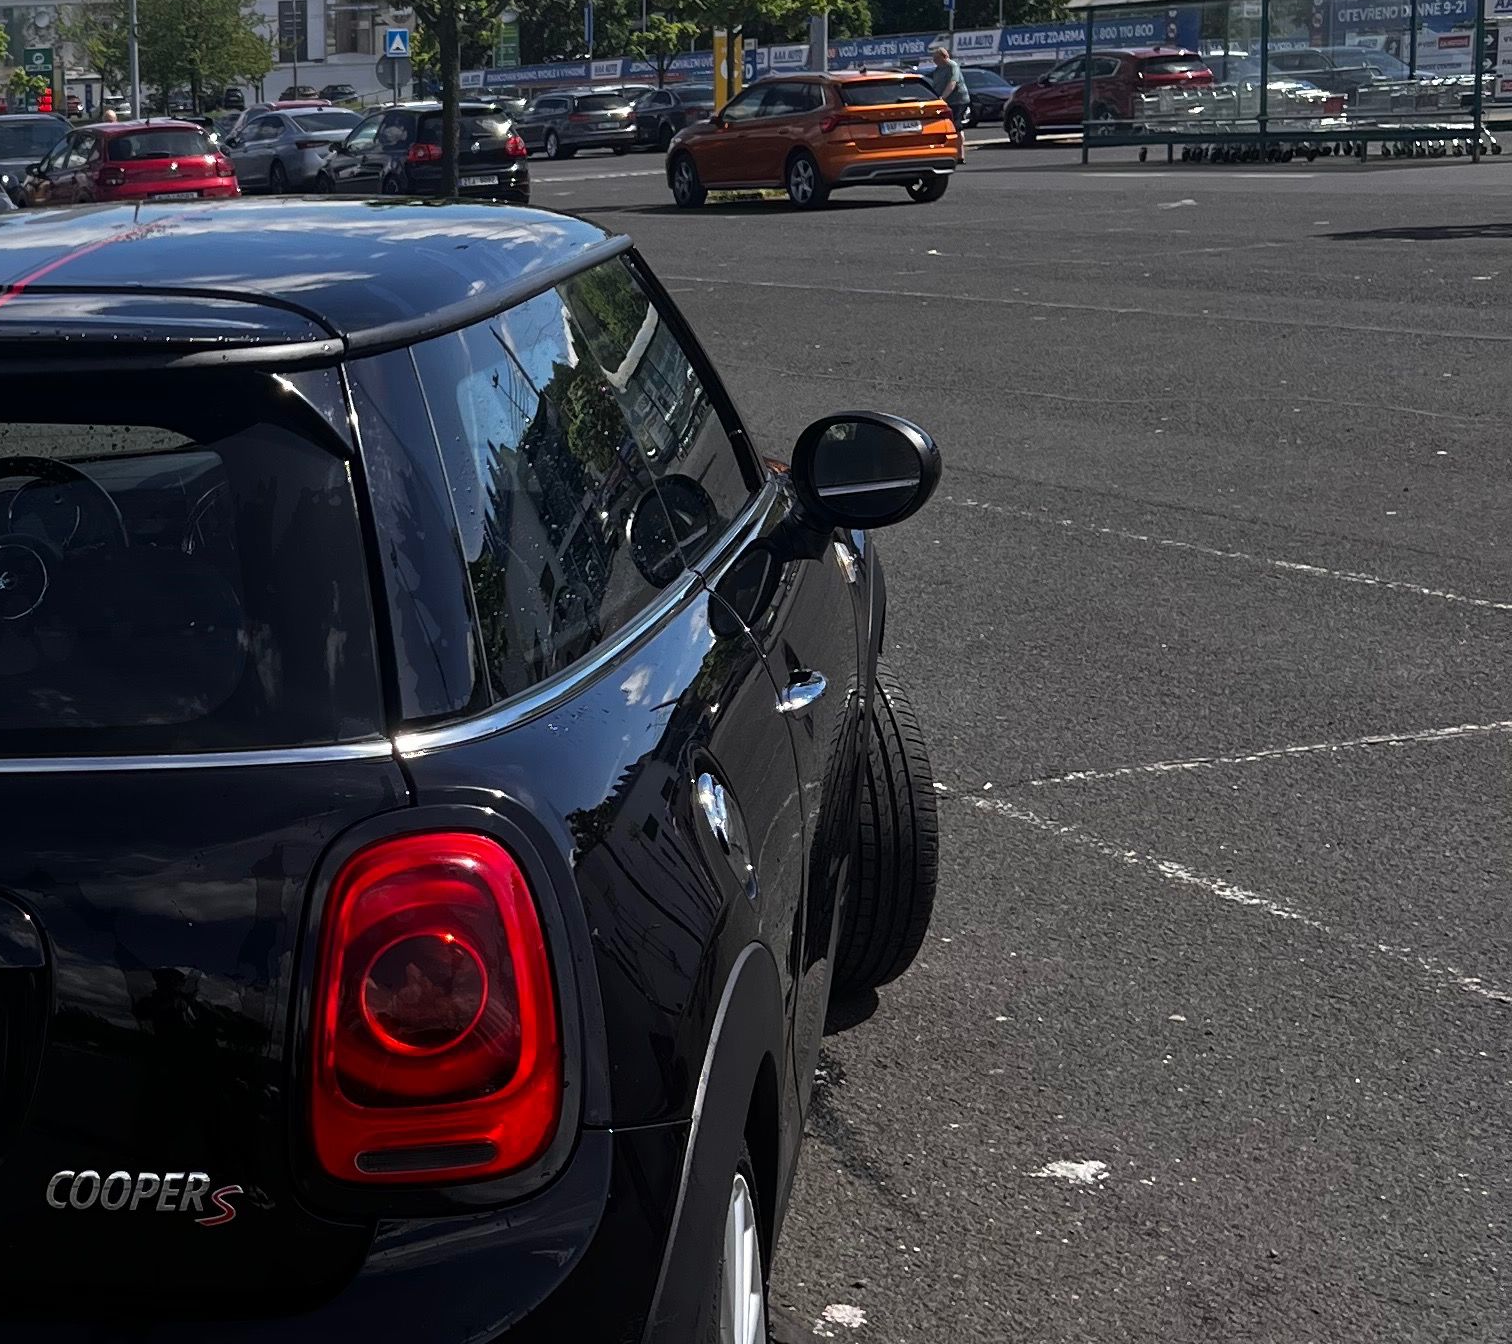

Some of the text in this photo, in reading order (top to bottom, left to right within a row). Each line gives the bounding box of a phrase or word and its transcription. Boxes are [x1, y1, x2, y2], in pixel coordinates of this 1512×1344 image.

[1401, 1, 1441, 18] DNNĚ
[1444, 0, 1467, 14] 9-21
[1007, 31, 1046, 46] VOLEJTE
[1047, 29, 1085, 43] ZDARMA
[45, 1169, 244, 1227] COOPER S
